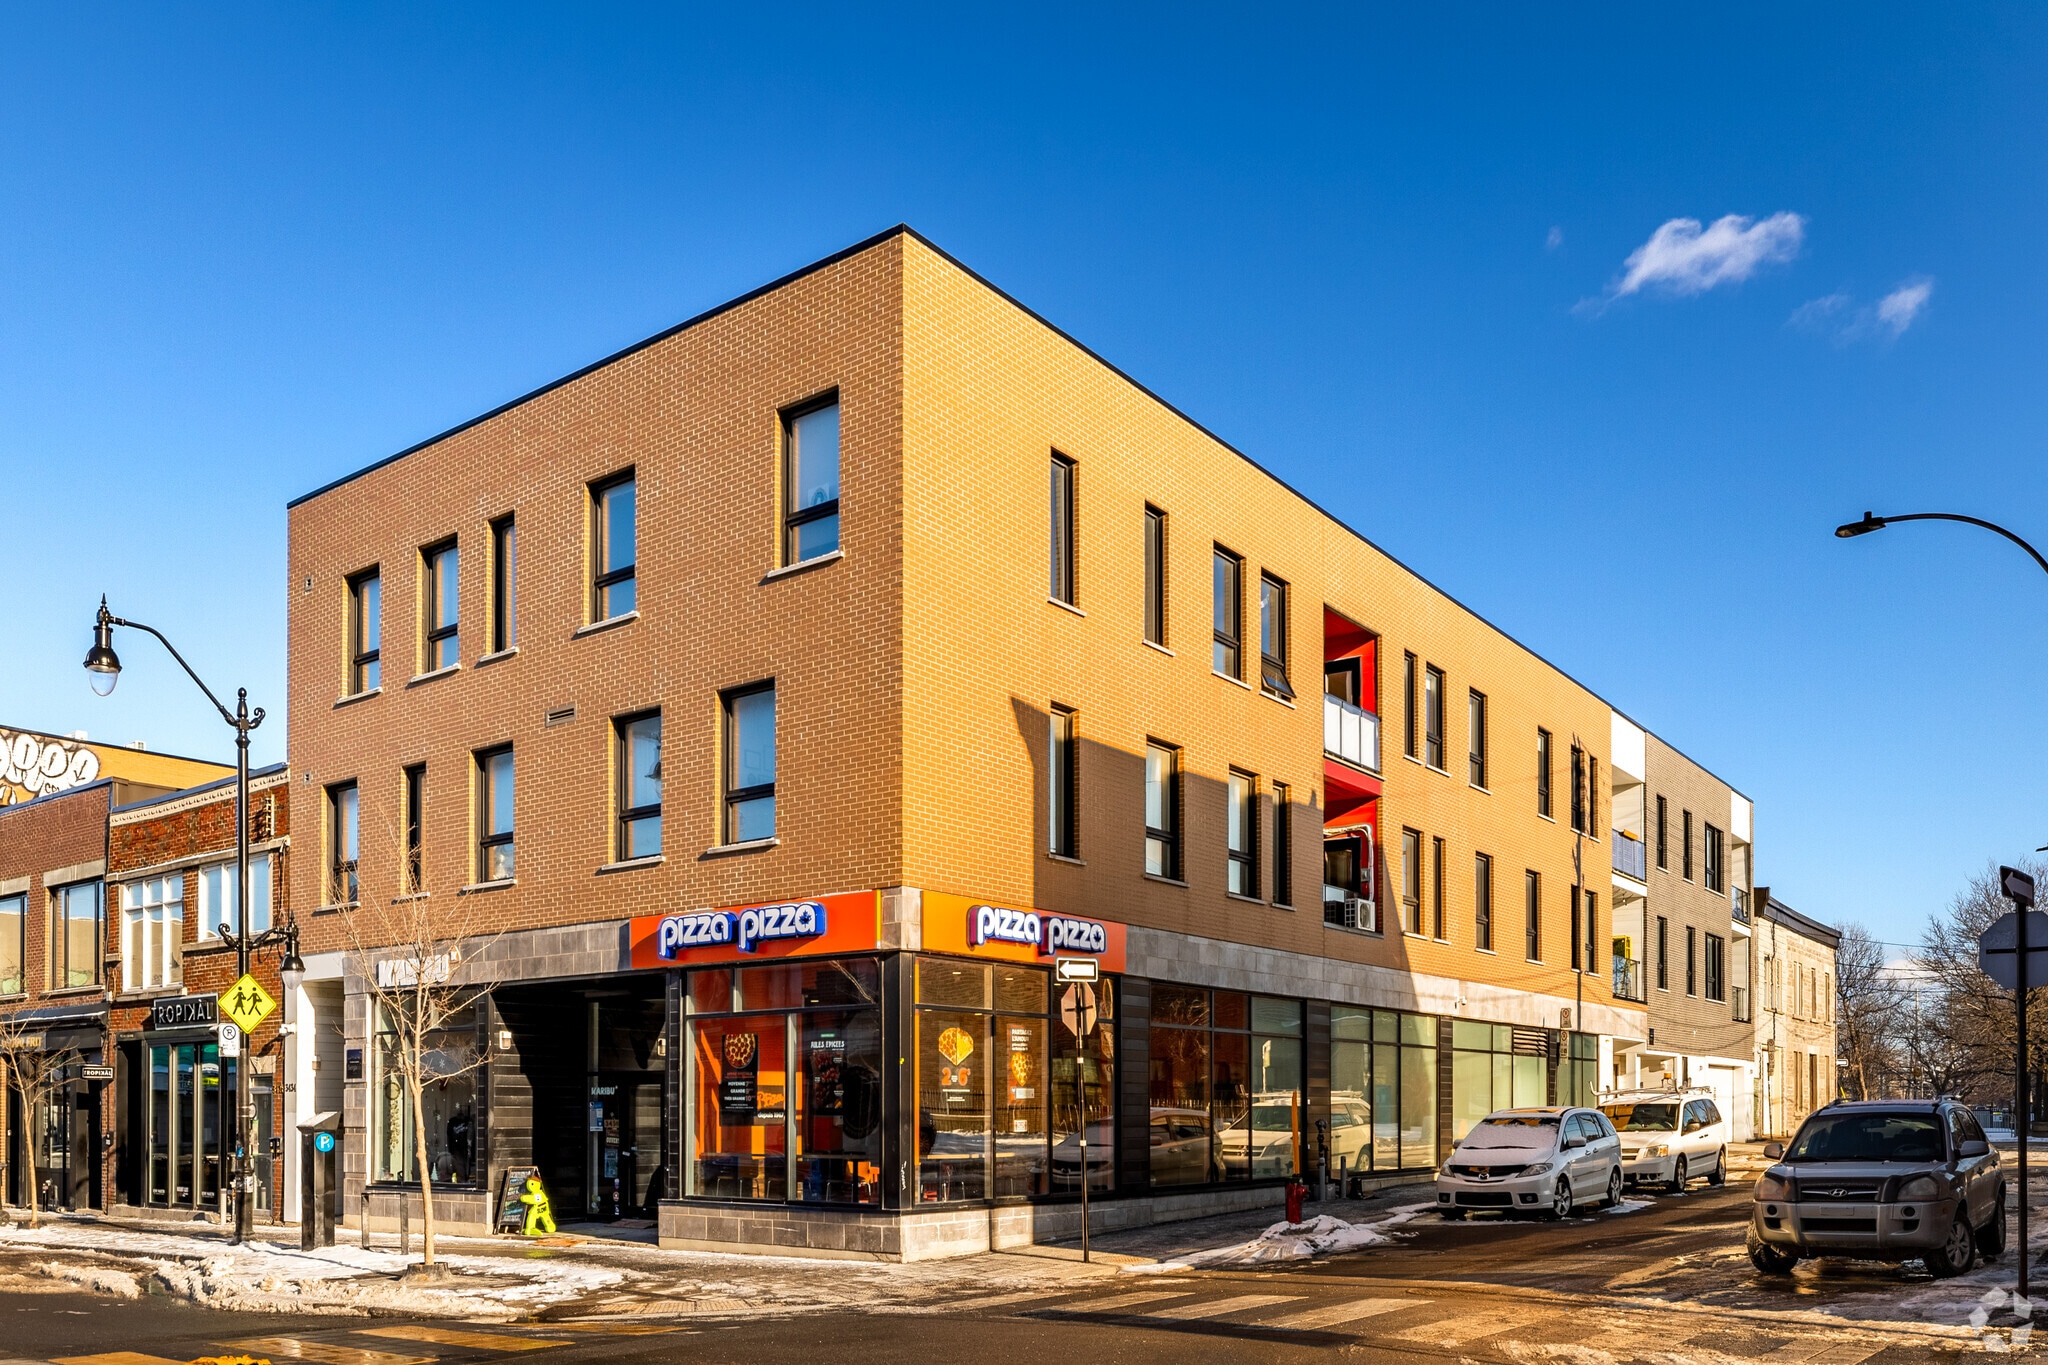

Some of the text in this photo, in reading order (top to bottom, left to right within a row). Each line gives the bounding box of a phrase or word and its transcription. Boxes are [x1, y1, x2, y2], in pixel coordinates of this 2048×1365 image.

[659, 902, 822, 958] pizza pizza
[974, 905, 1105, 955] pizza pizza
[591, 1087, 615, 1095] KARIBU
